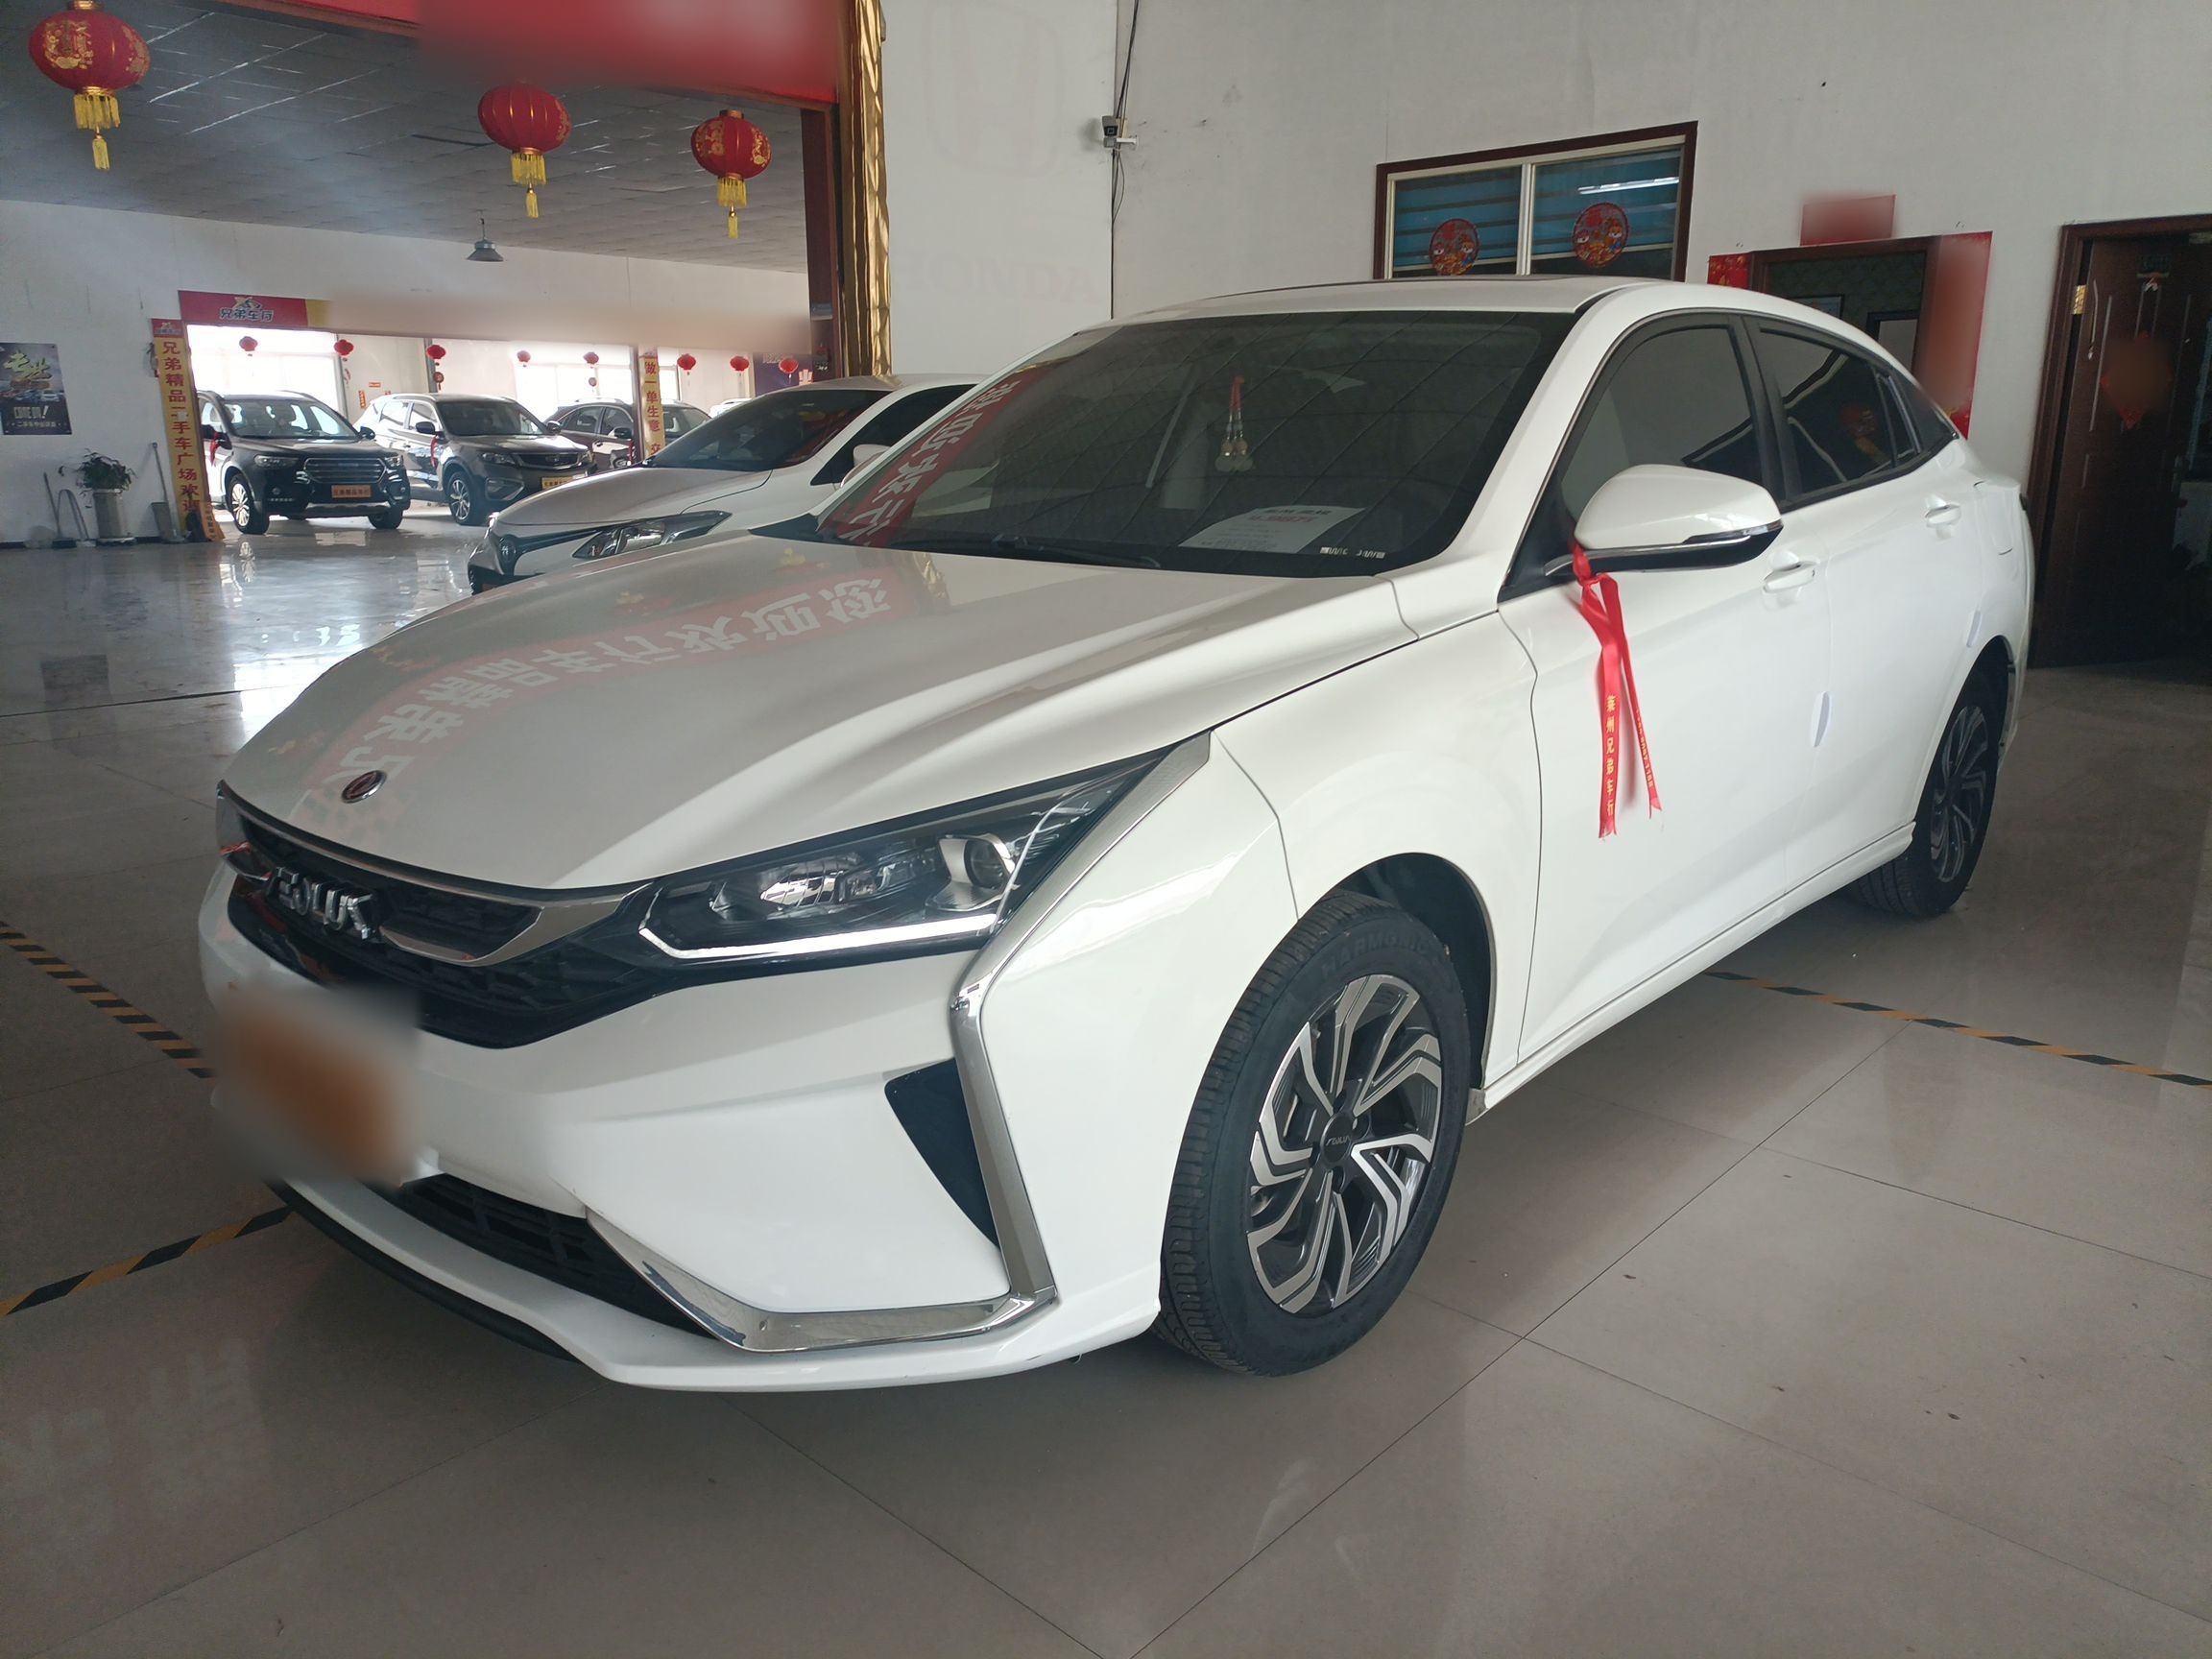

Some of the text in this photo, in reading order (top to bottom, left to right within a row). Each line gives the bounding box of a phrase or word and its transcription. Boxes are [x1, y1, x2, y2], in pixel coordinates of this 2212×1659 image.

[220, 308, 275, 322] 兄弟车行
[645, 361, 661, 431] 做一单生意
